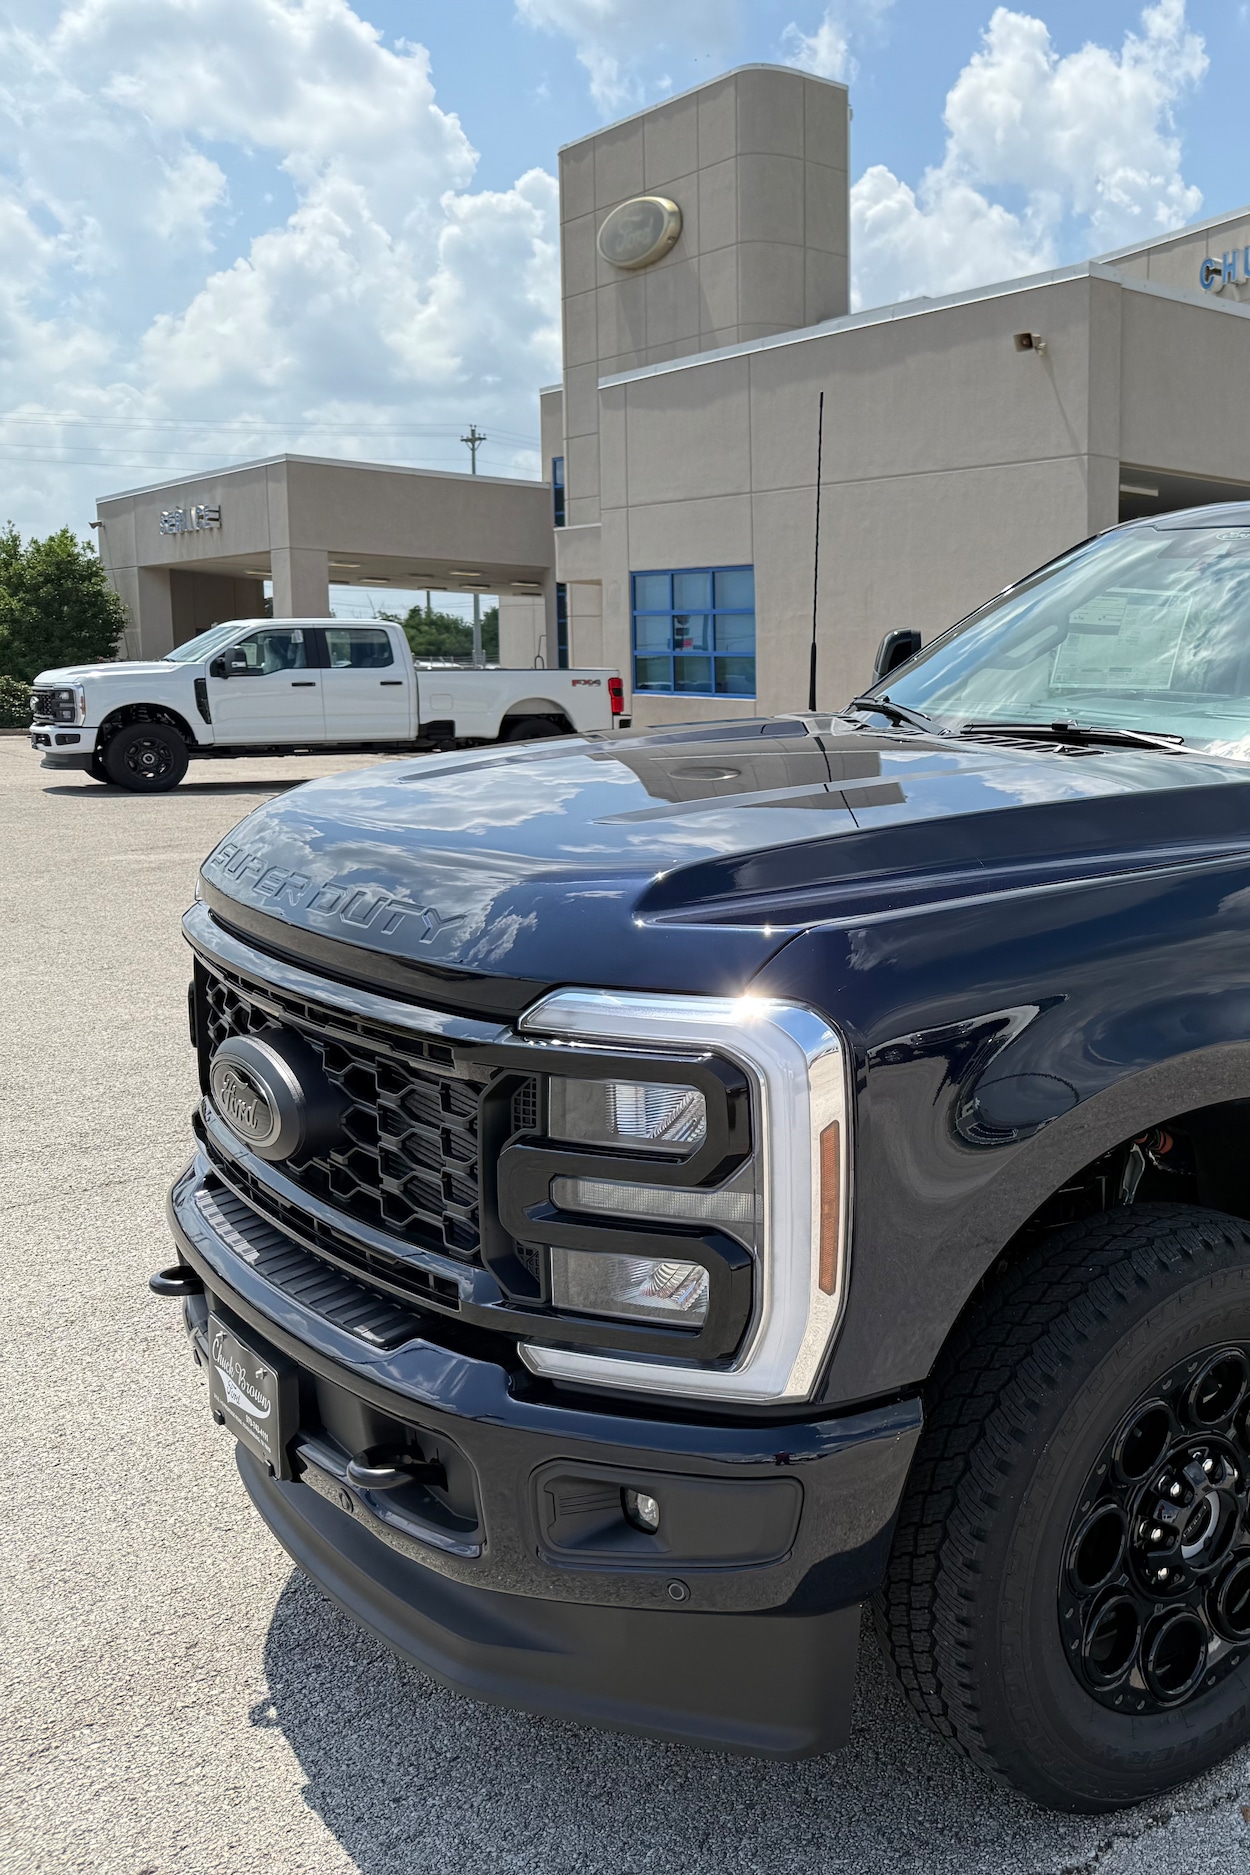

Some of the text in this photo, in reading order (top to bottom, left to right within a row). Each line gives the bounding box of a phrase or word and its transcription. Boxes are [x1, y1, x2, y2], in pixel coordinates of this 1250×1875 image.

[210, 842, 468, 945] SUPER DUTY
[212, 1337, 271, 1410] Chuck Brown
[227, 1380, 241, 1405] Ford
